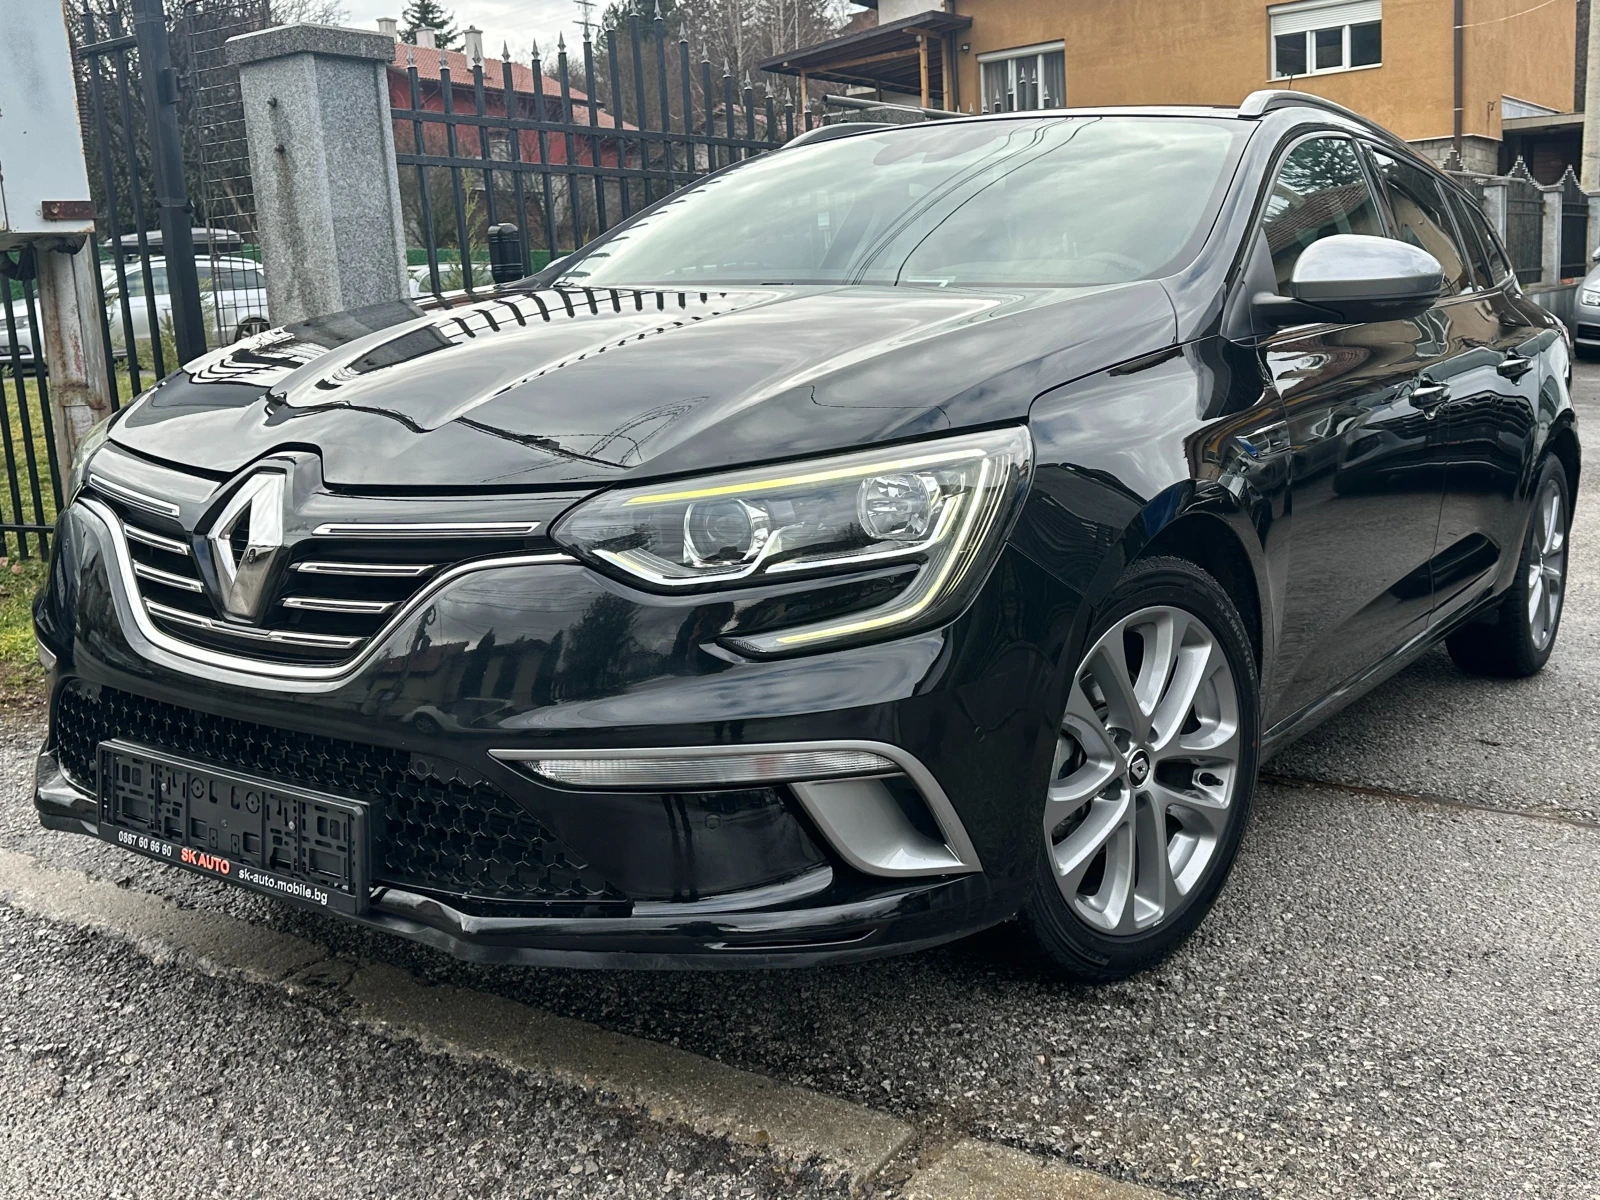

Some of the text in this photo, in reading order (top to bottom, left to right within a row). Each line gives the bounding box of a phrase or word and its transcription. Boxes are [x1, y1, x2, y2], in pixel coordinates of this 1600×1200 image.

[118, 830, 172, 857] 0887 60 66 60
[181, 847, 230, 875] SK AUTO
[238, 868, 328, 905] sk-auto.mobile.bg
